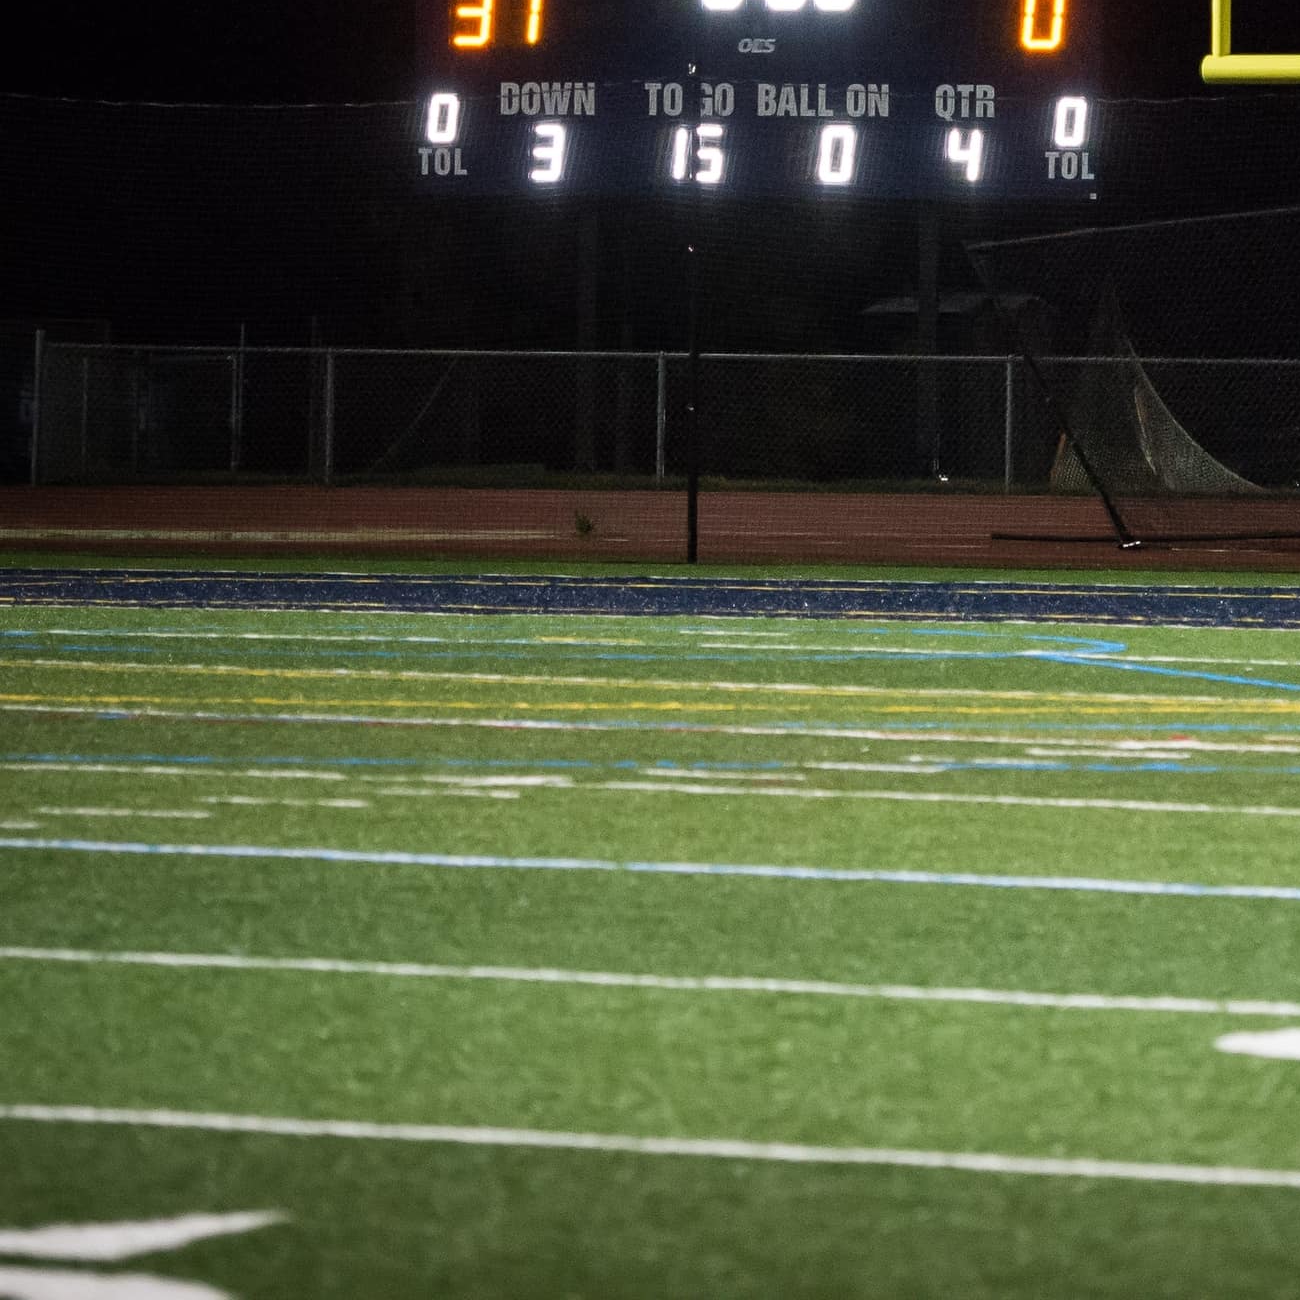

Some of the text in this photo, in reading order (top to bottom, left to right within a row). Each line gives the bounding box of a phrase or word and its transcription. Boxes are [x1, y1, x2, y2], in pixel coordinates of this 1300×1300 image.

[427, 93, 461, 143] 0
[500, 82, 596, 116] DOWN
[645, 83, 684, 117] TO
[757, 84, 889, 118] BALL ON
[935, 84, 995, 121] QTR
[1055, 97, 1088, 147] 0
[417, 148, 468, 176] TOL
[531, 123, 566, 183] 3
[673, 124, 724, 184] 15
[818, 124, 857, 184] 0
[948, 127, 983, 182] 4
[1045, 151, 1095, 180] TOL
